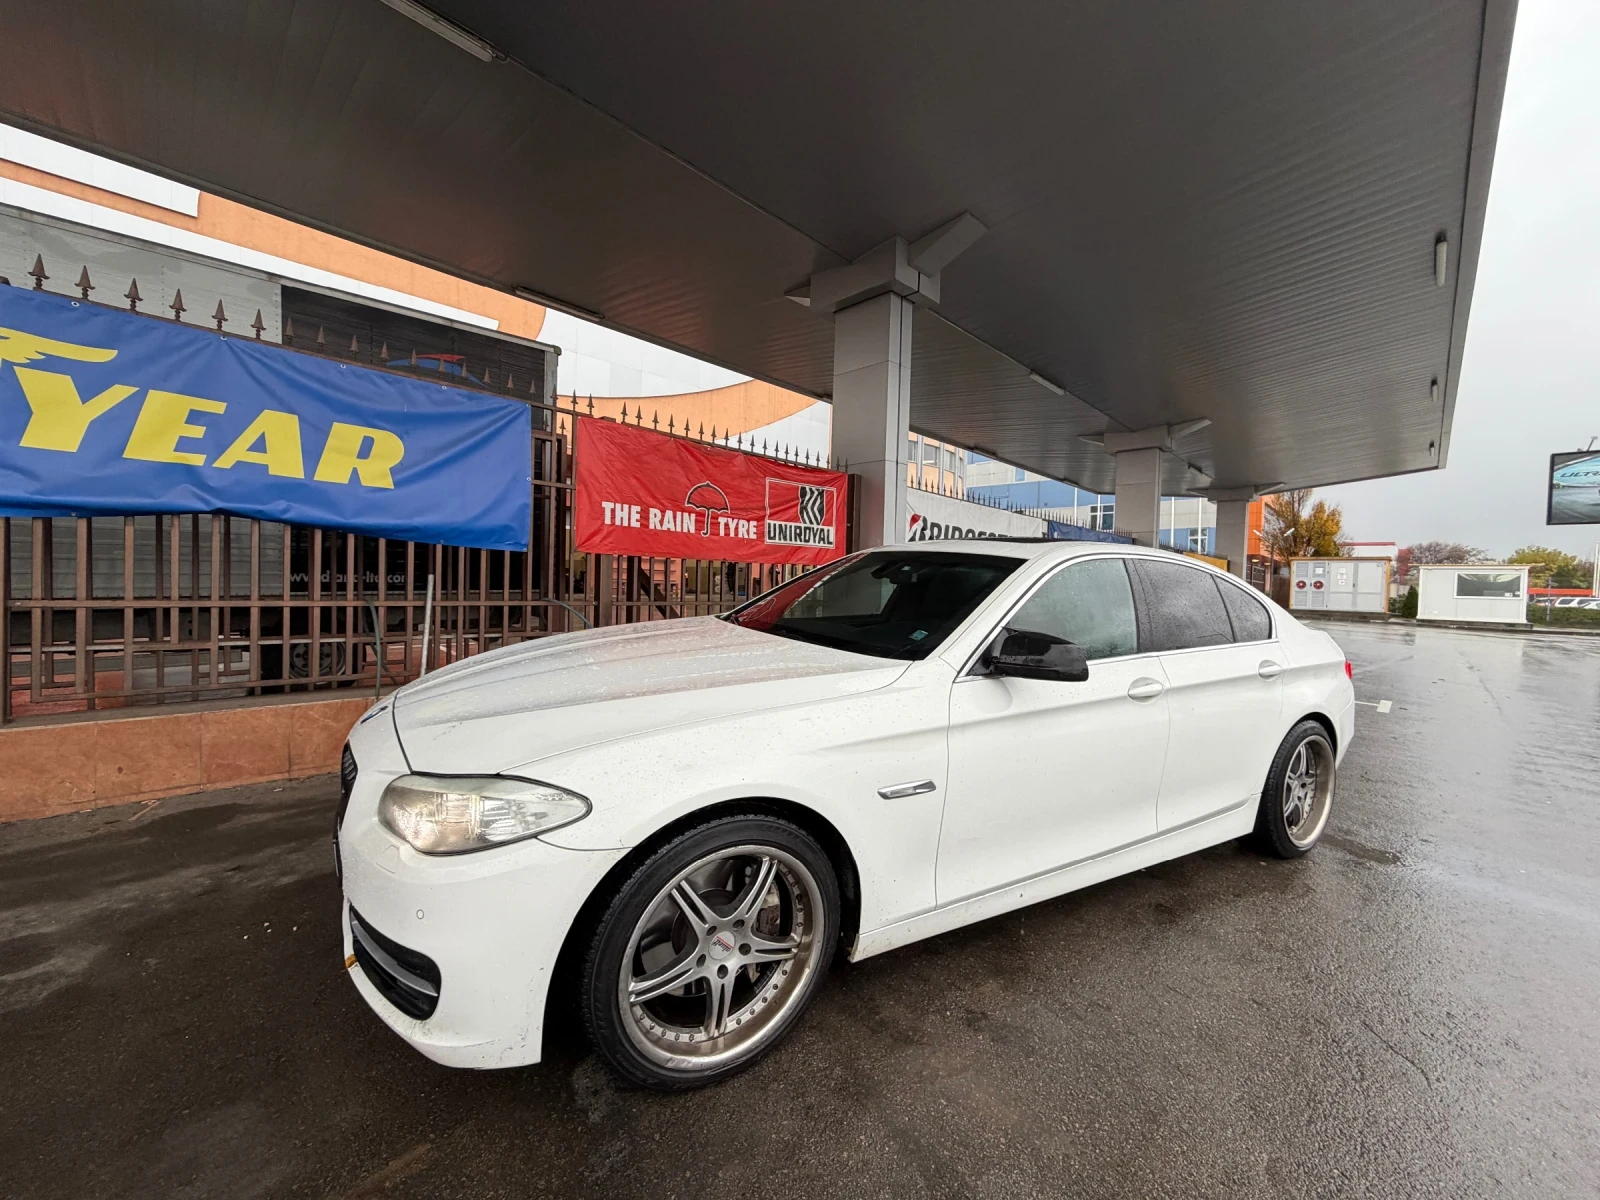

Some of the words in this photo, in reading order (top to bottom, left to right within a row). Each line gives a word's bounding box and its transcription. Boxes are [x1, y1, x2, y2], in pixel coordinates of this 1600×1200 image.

[13, 365, 404, 489] YEAR
[602, 501, 641, 528] THE
[649, 508, 696, 534] RAIN
[718, 516, 757, 539] TYRE
[767, 523, 834, 545] UNIROYAL
